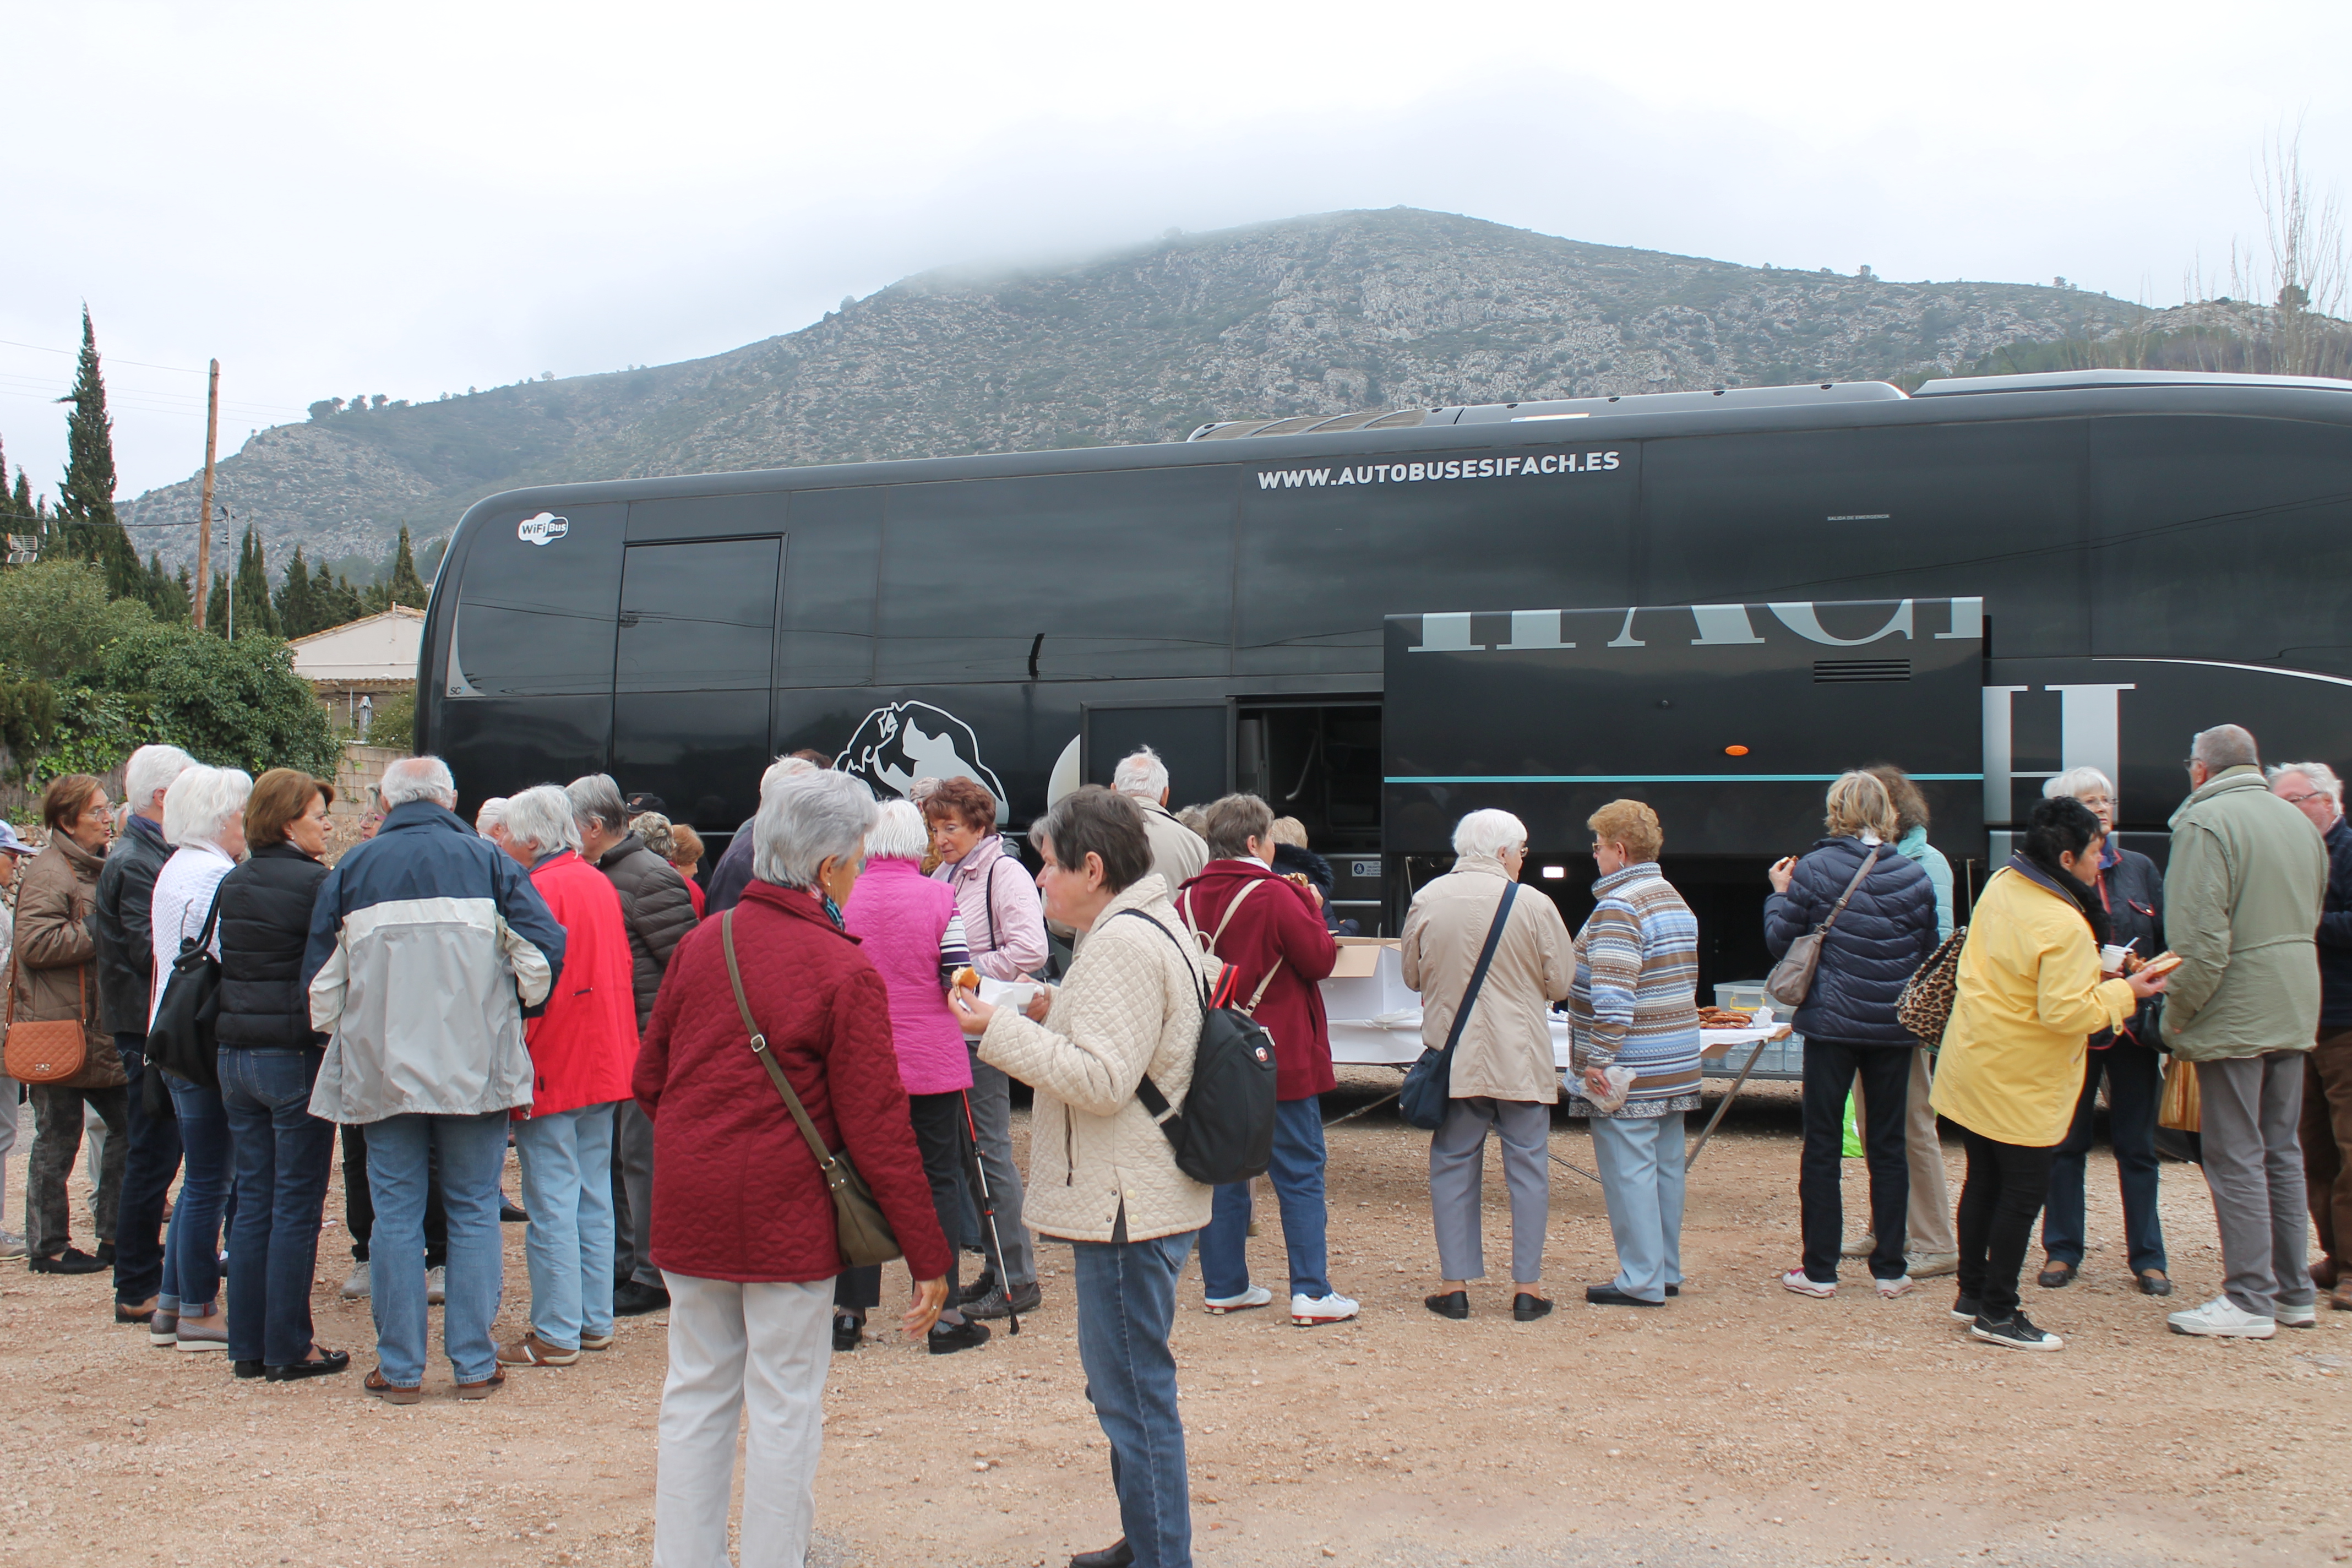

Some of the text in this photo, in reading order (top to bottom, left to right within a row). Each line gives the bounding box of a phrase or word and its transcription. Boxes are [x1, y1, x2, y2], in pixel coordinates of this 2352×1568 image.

[1257, 451, 1620, 490] WWW.AUTOBUSESIFACH.ES
[522, 523, 567, 535] WiFi Bus
[450, 686, 466, 695] SC7
